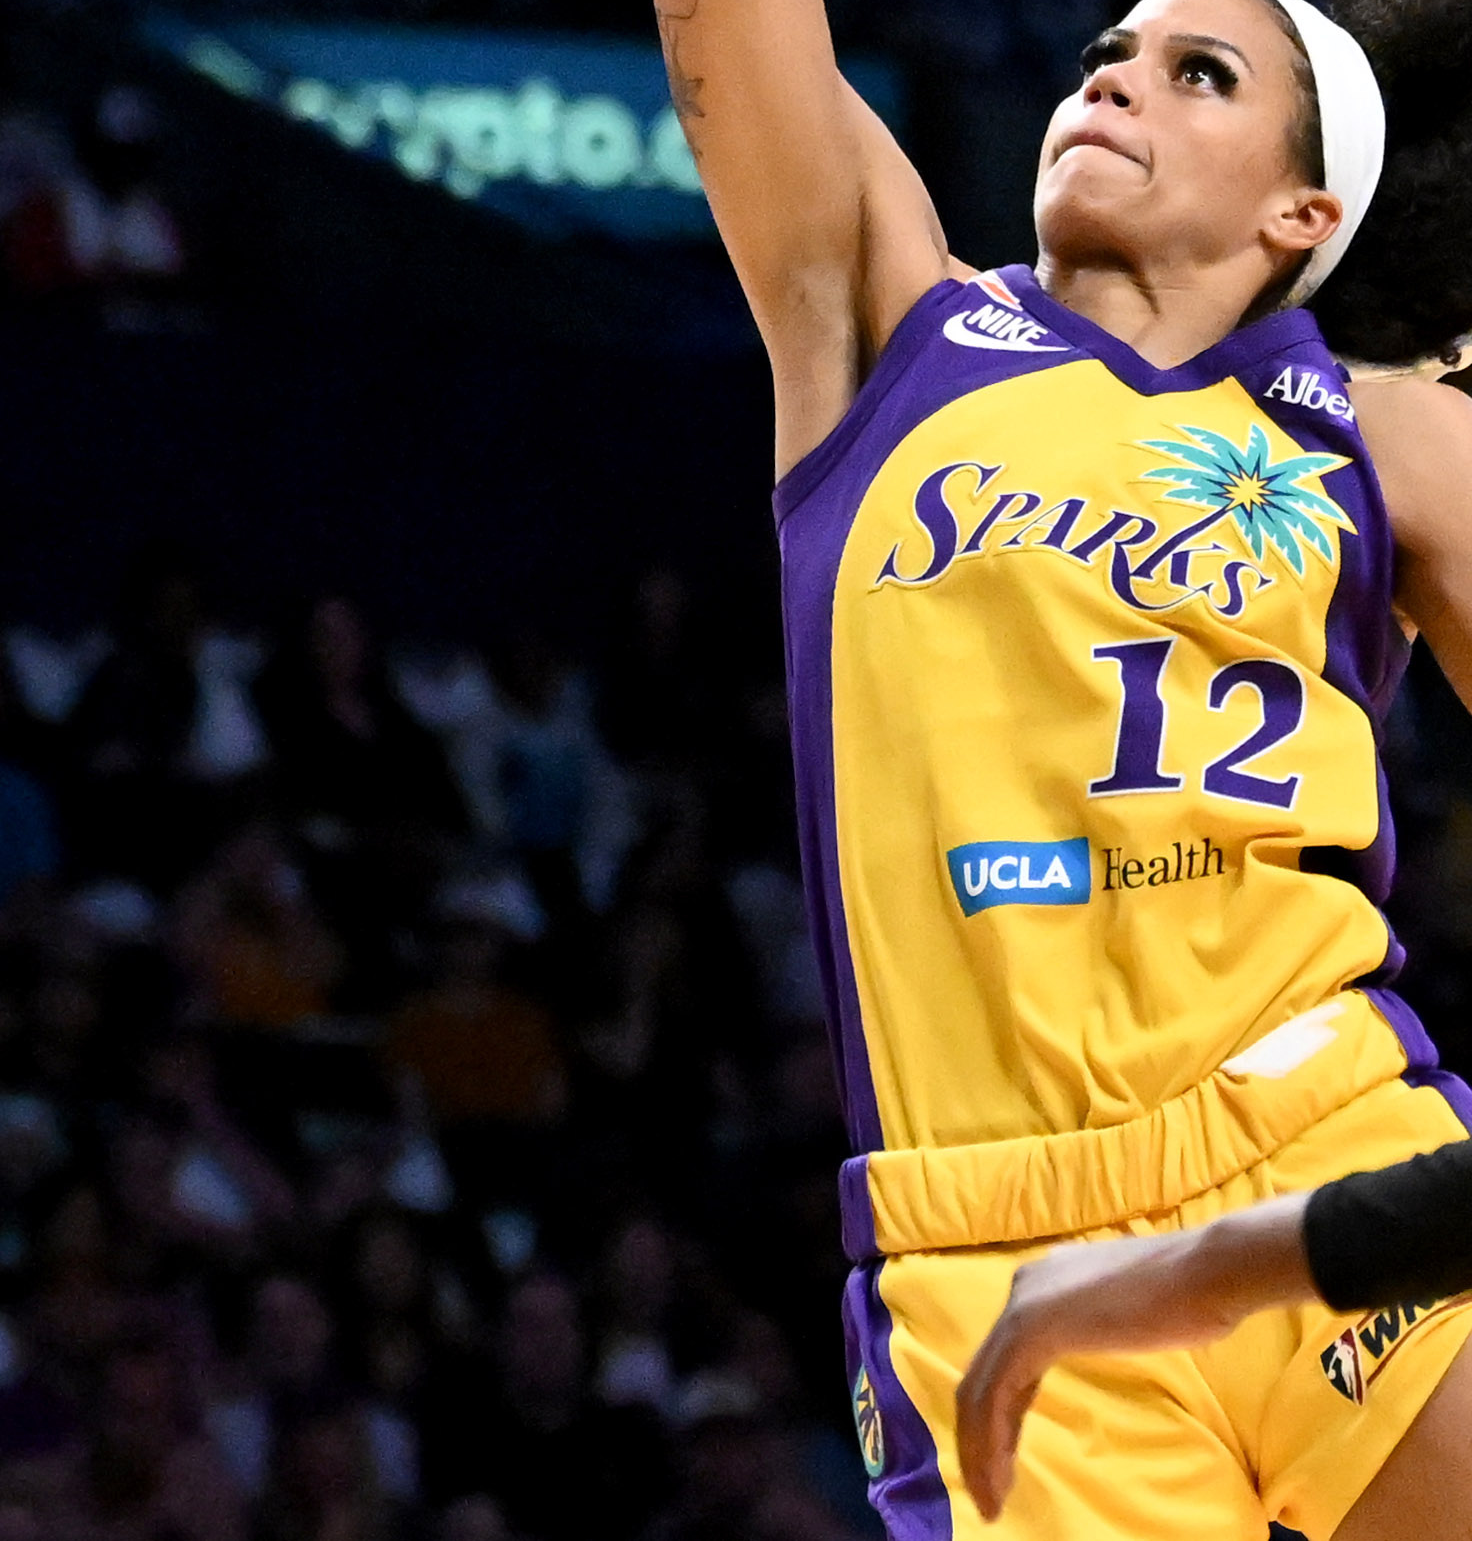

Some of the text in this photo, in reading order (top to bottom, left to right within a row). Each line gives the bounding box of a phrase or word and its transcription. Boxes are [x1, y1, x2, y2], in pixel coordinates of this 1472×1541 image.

[966, 303, 1049, 344] NIKE
[874, 462, 1271, 618] SPARKS
[1087, 636, 1305, 810] 12
[961, 839, 1225, 897] UCLA Health
